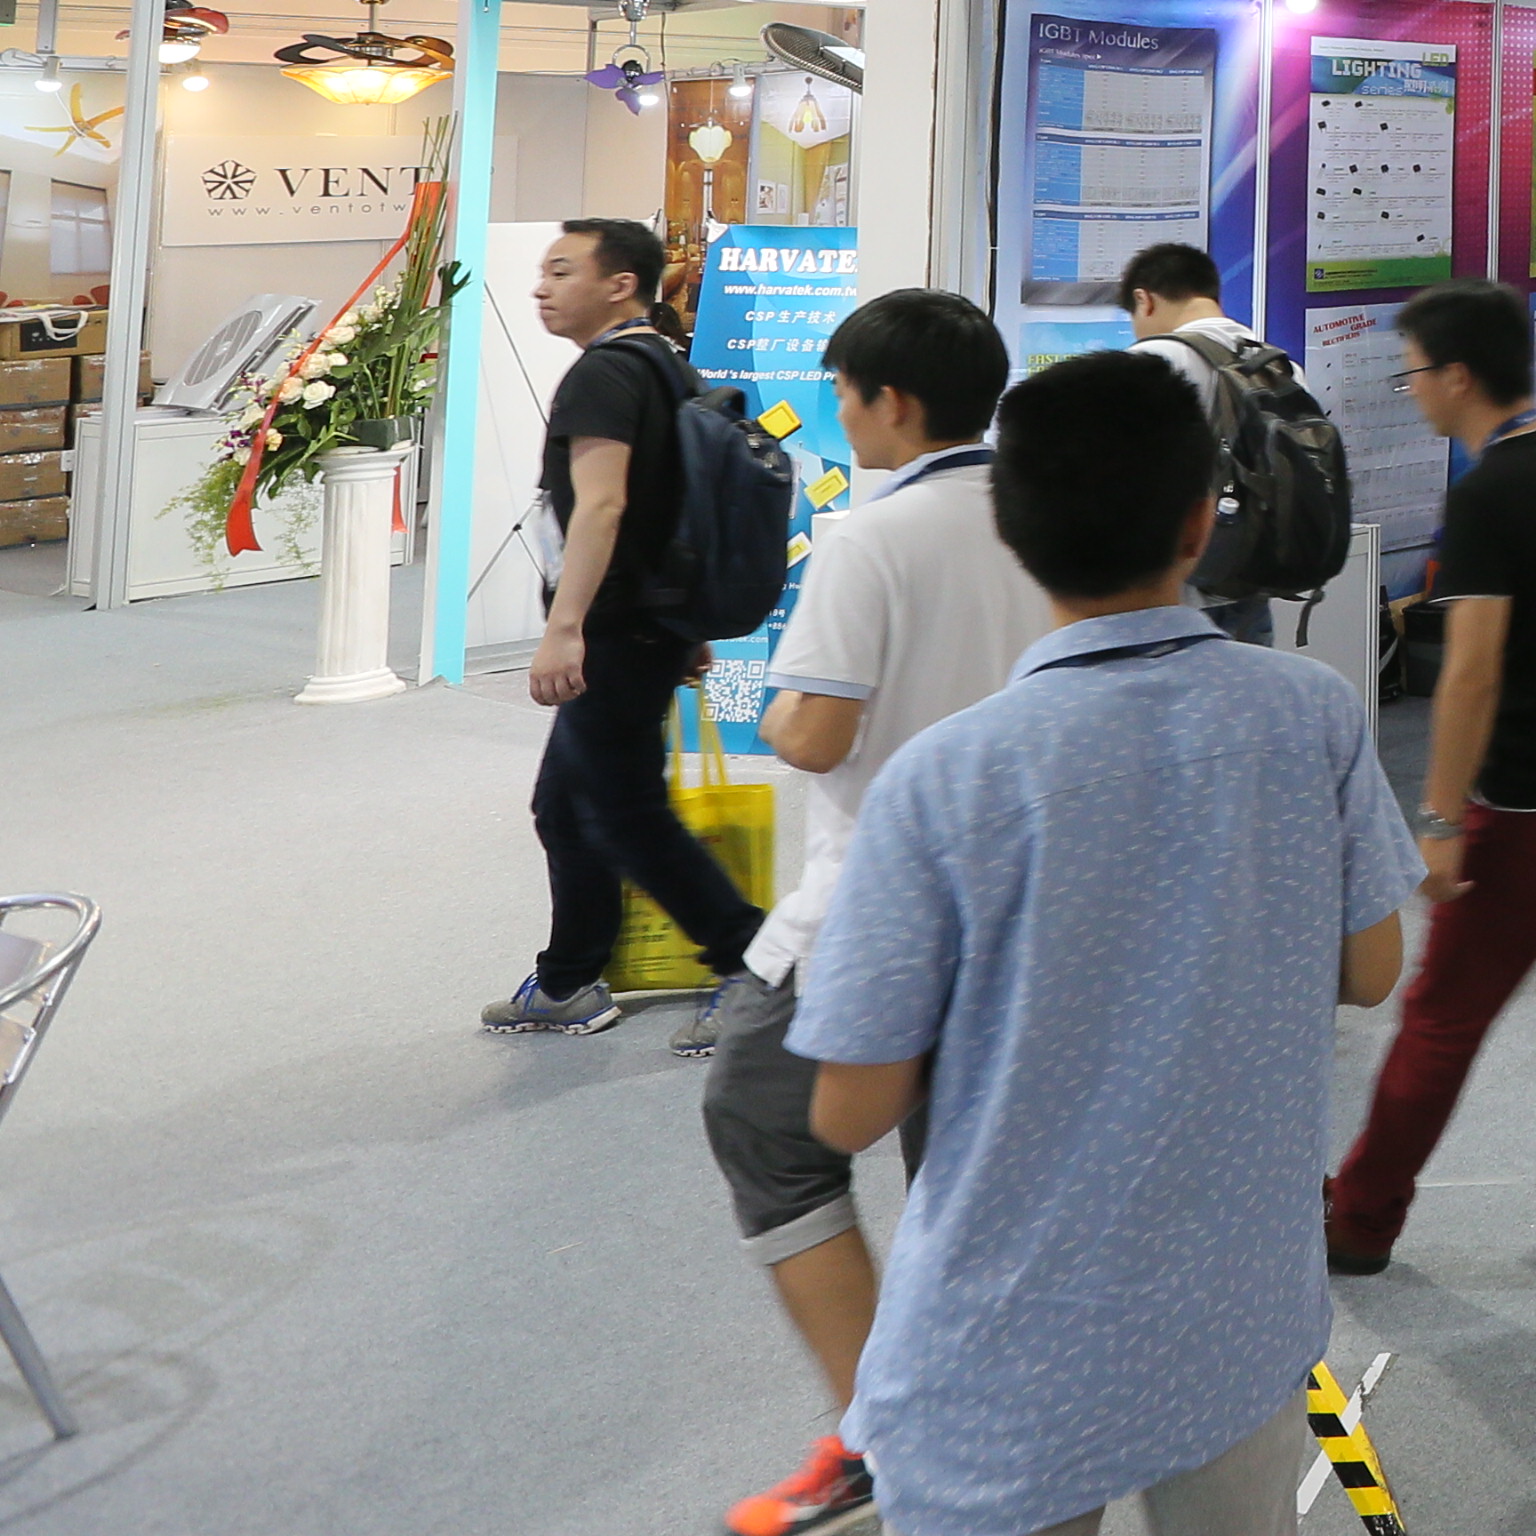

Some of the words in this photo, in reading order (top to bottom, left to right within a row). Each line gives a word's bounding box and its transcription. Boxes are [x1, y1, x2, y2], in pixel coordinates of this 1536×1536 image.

[1039, 23, 1082, 43] IGBT
[1088, 30, 1160, 50] Modules
[1331, 58, 1423, 79] LIGHTING
[274, 166, 436, 198] VENT
[718, 246, 859, 274] HARVATE
[745, 310, 776, 322] CSP
[777, 309, 837, 325] 生产技术
[1313, 313, 1366, 334] AUTOMOTIVE
[1350, 318, 1377, 332] GRADE
[739, 370, 776, 383] largest
[776, 371, 800, 381] CSP
[800, 371, 822, 382] LED
